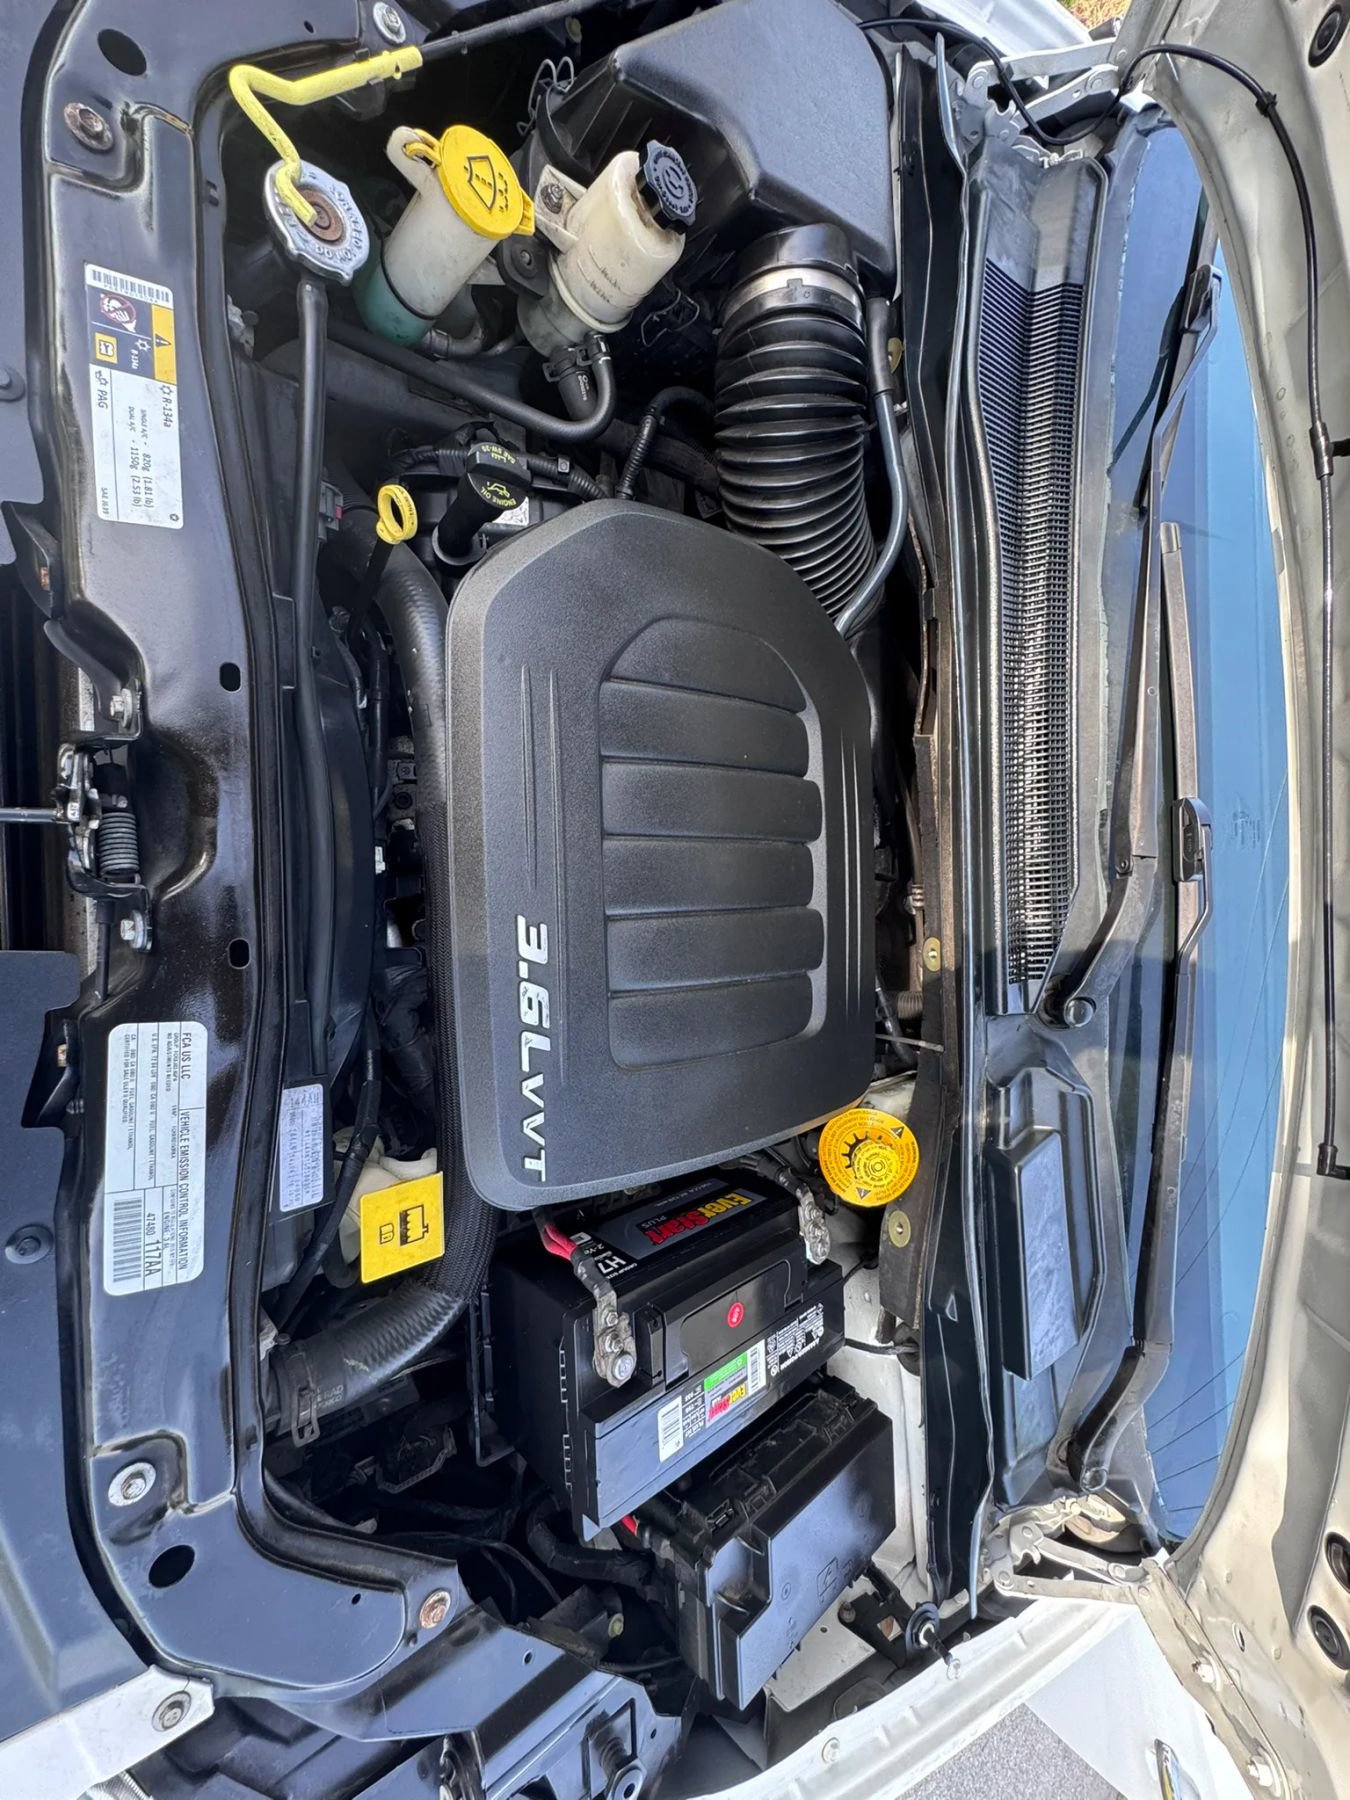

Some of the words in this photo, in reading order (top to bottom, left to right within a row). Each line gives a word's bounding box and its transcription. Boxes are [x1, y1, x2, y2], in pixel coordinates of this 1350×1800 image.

[97, 389, 108, 408] PAG
[163, 397, 172, 428] R-134a
[129, 447, 139, 469] 1150g
[142, 453, 151, 472] 820g
[130, 475, 140, 494] (2.53
[142, 476, 152, 495] (1.81
[480, 486, 490, 499] OIL
[131, 497, 141, 507] lb)
[144, 497, 154, 508] lb)
[490, 497, 516, 506] ENGINE
[182, 1032, 191, 1048] FCA
[181, 1051, 191, 1062] US
[181, 1065, 191, 1079] LLC
[180, 1111, 190, 1142] VEHICLE
[179, 1145, 189, 1181] EMISSION
[179, 1183, 189, 1217] CONTROL
[146, 1213, 155, 1235] 47480
[641, 1215, 667, 1228] PLUS
[645, 1192, 752, 1245] EverStart
[178, 1220, 188, 1270] INFORMATION
[145, 1240, 162, 1277] 117AA
[597, 1256, 626, 1274] H7
